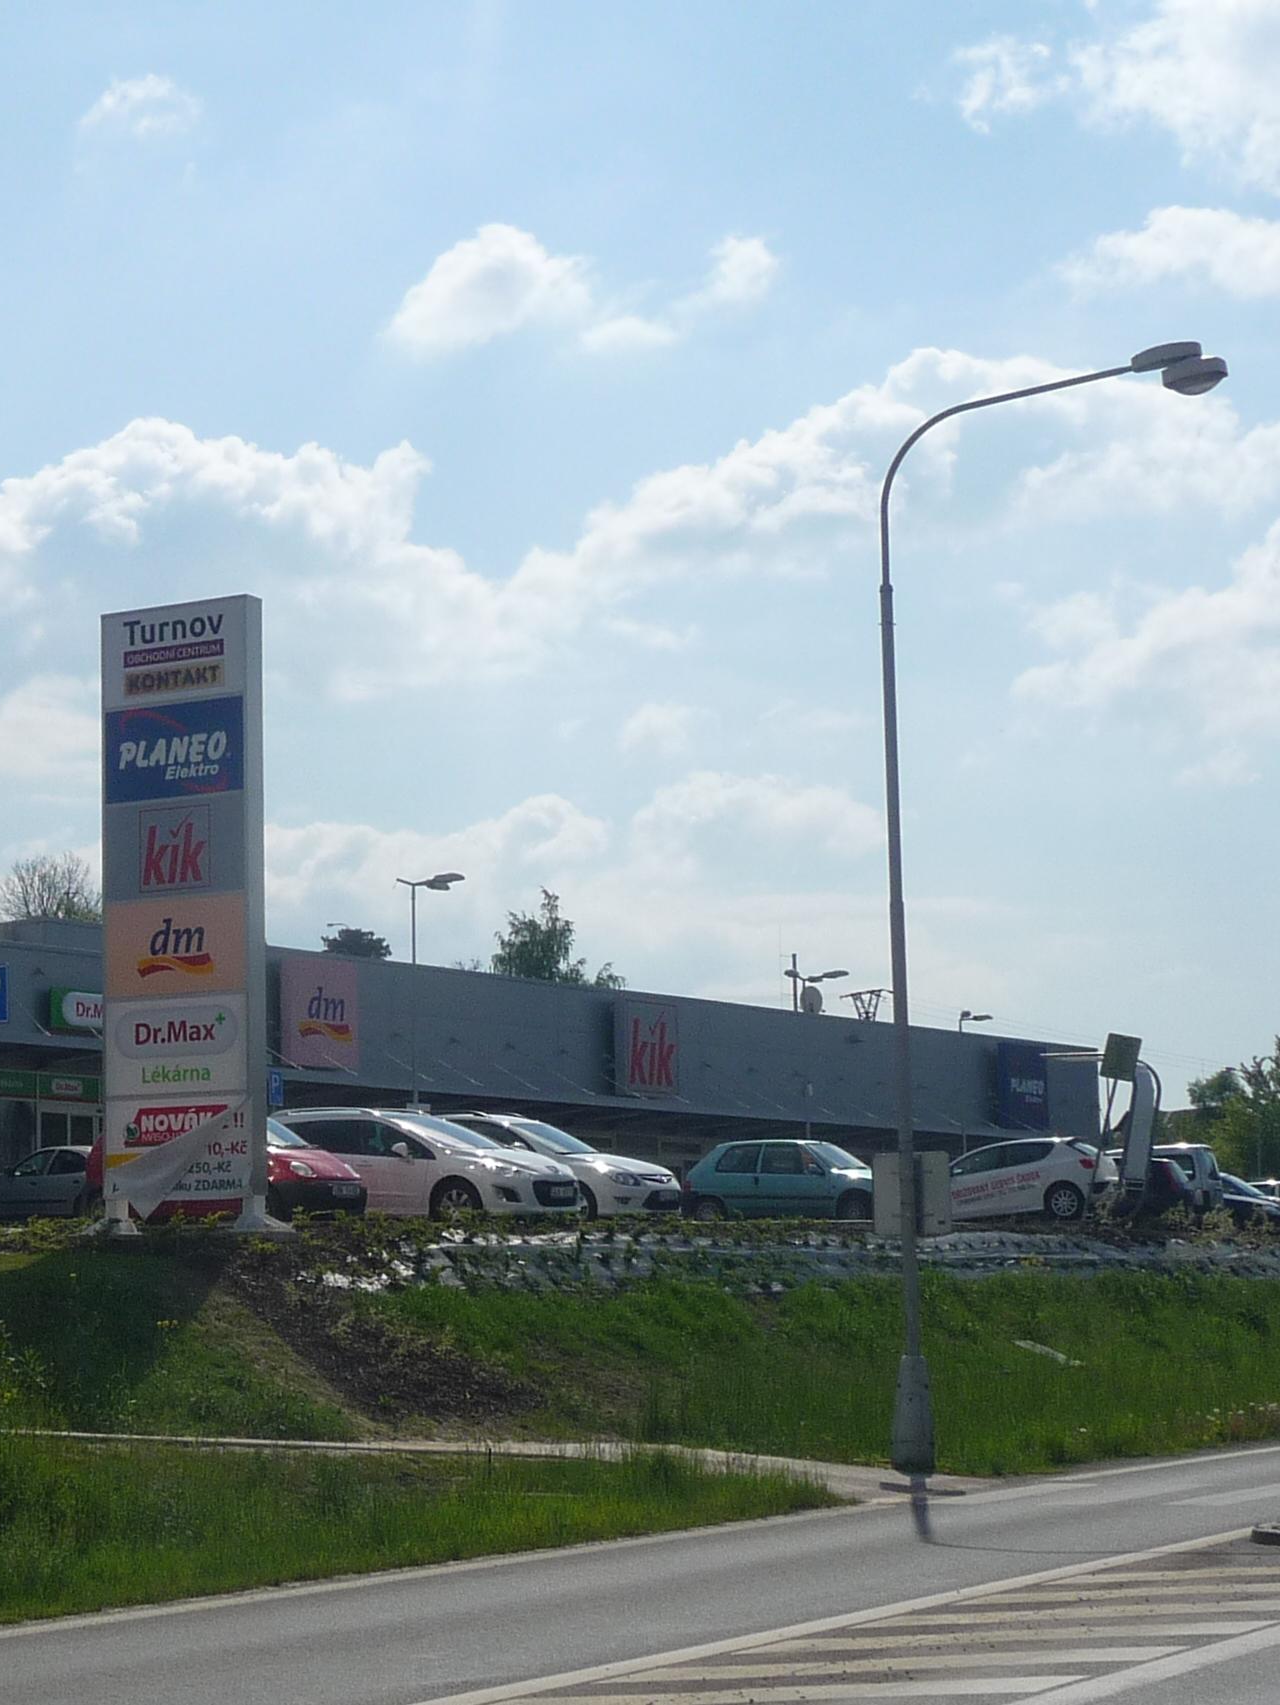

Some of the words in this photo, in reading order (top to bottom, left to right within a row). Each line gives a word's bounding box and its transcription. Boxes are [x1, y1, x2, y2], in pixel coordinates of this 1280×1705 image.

[123, 614, 223, 646] Turnov
[127, 647, 175, 665] OBCHODNÍ
[177, 644, 220, 659] CENTRUM
[128, 664, 220, 692] KONTAKT
[119, 731, 227, 770] PLANEO
[165, 764, 219, 780] Elektro
[150, 918, 205, 955] dm
[76, 1002, 103, 1018] Dr.M
[308, 987, 344, 1022] dm
[134, 1020, 215, 1045] Dr.Max
[142, 1065, 211, 1084] Lékárna
